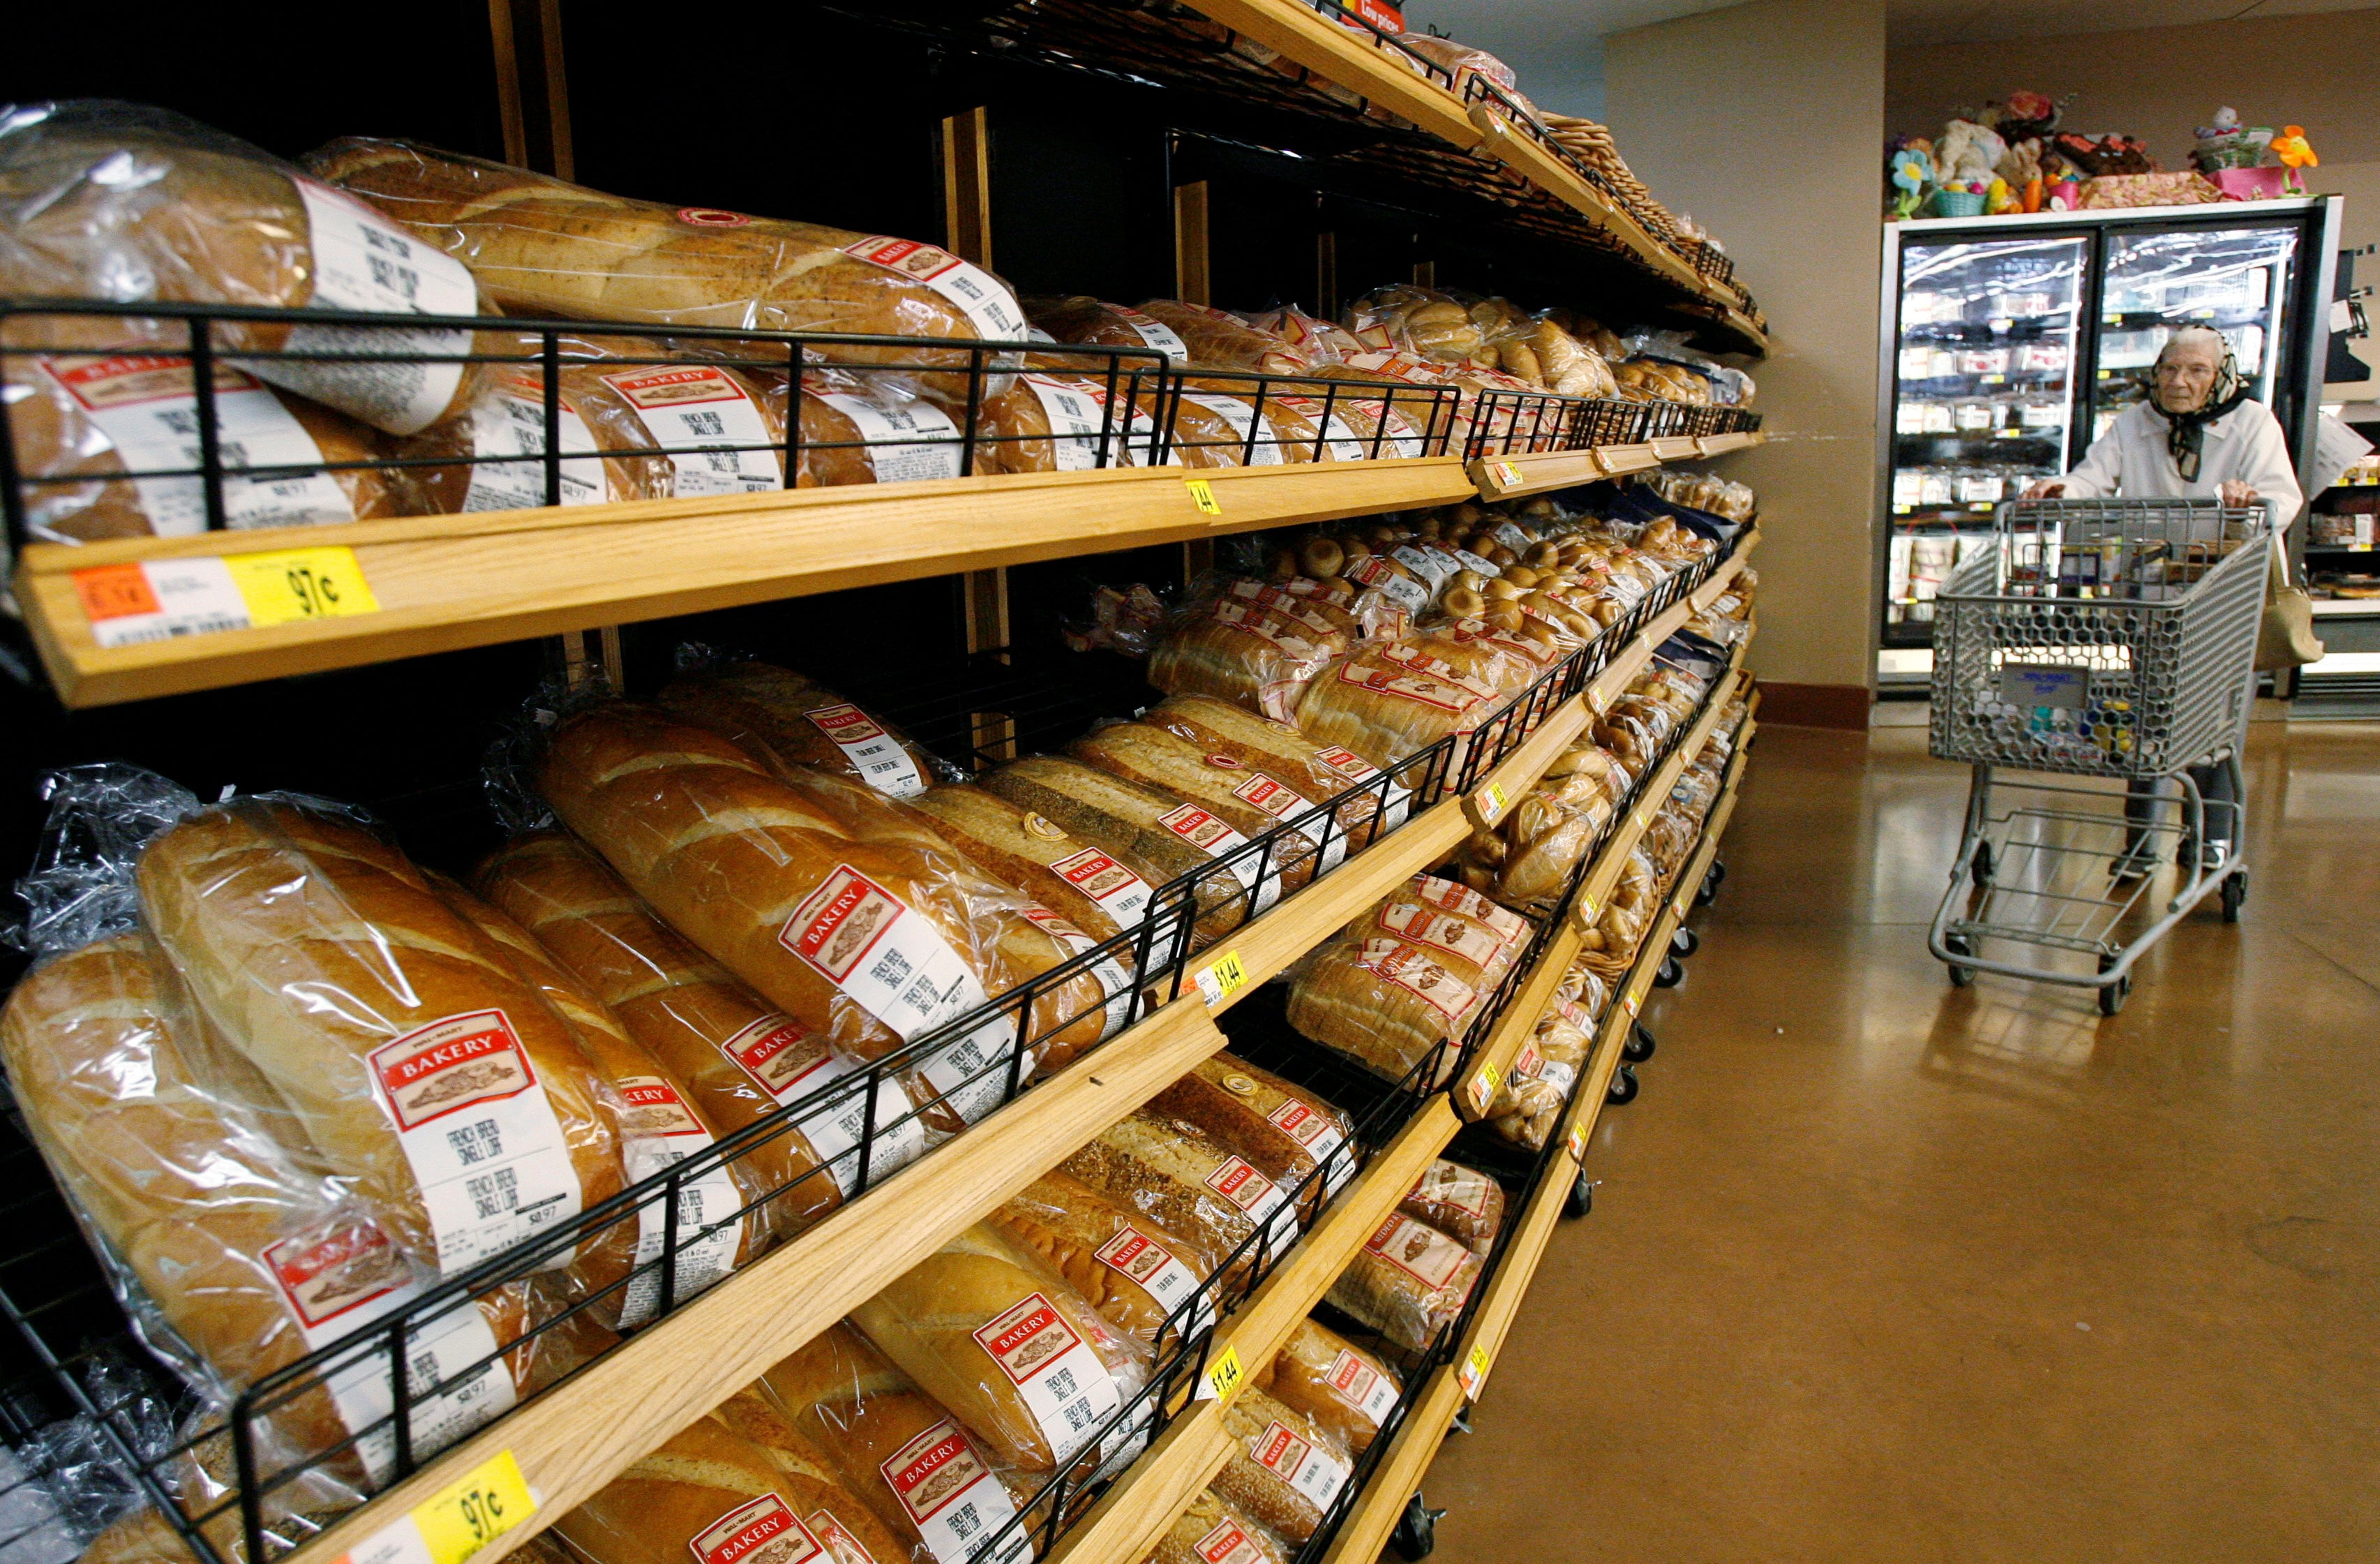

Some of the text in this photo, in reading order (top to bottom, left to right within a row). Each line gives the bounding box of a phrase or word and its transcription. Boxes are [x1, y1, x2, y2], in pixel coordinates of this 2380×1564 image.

[633, 371, 704, 387] BAKERY
[1251, 783, 1275, 800] BAKERY
[1177, 813, 1204, 831] BAKERY
[1072, 860, 1107, 879] BAKERY
[807, 888, 858, 945] BAKERY
[1215, 958, 1241, 988] $1.44
[753, 1026, 798, 1059] BAKE
[401, 1035, 493, 1078] BAKERY
[625, 1088, 664, 1103] KERY
[1284, 1109, 1305, 1127] BAKERY
[1223, 1168, 1248, 1190] BAKERY
[1116, 1239, 1143, 1263] BAKERY
[998, 1313, 1046, 1348] BAKERY
[1212, 1357, 1237, 1392] $1.44
[1266, 1434, 1287, 1463] BAKERY
[906, 1441, 955, 1484] BAKERY
[721, 1517, 780, 1561] BAKERY
[1212, 1534, 1238, 1558] BAKERY
